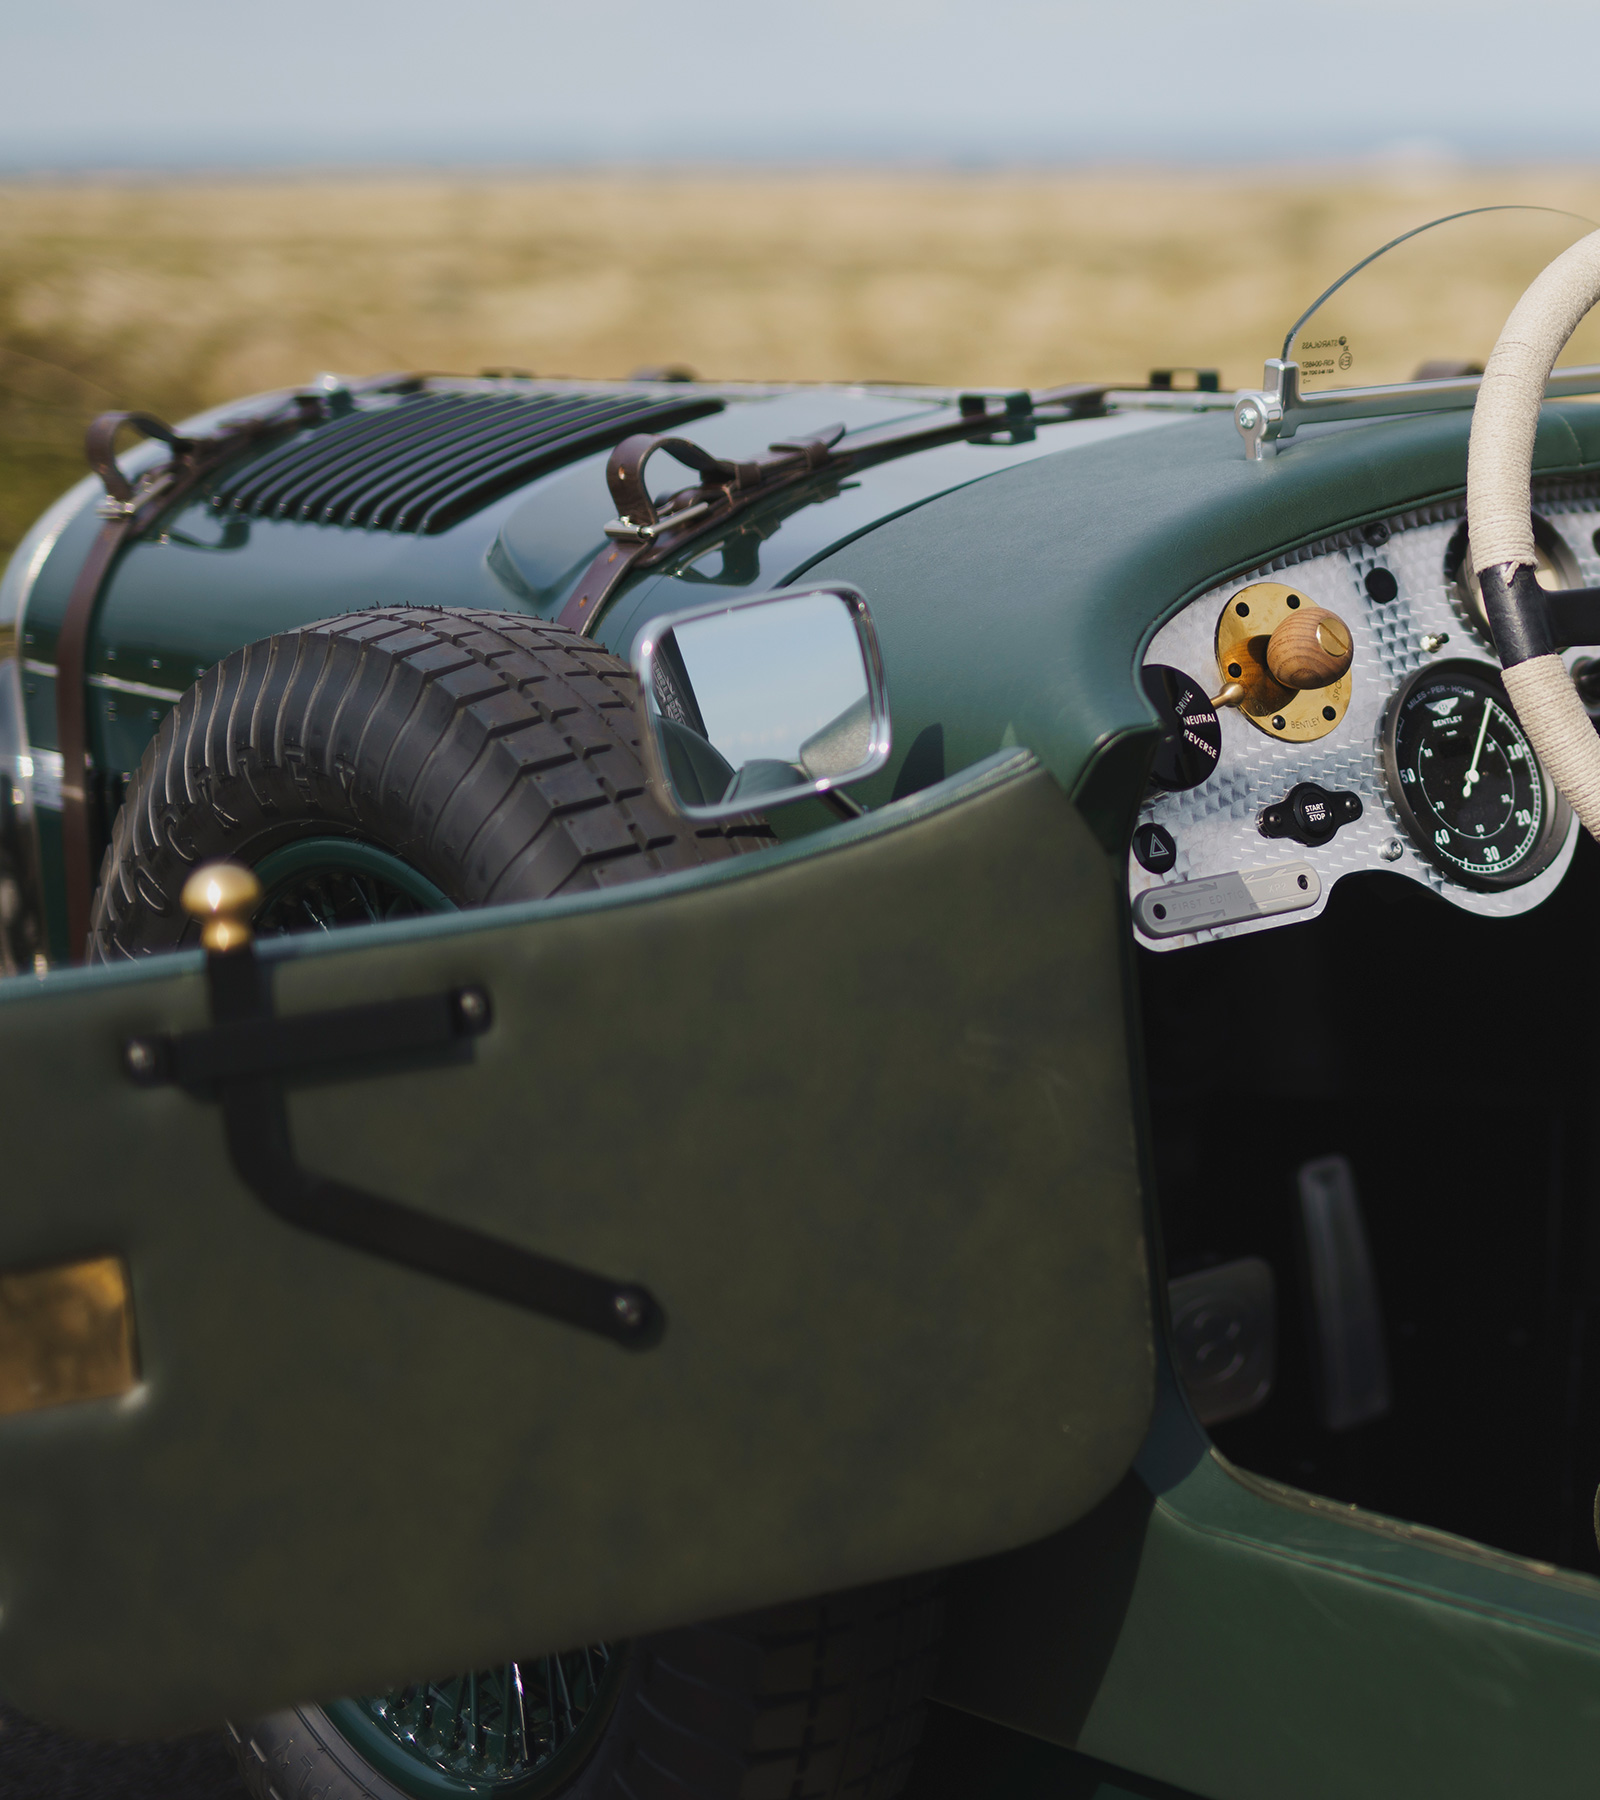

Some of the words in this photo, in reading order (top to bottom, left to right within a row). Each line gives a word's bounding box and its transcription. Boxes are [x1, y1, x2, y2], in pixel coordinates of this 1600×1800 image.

[1175, 690, 1194, 715] DRIVE
[1182, 713, 1216, 726] NEUTRAL
[1291, 716, 1320, 730] BENTLEY
[1432, 715, 1462, 728] BENTLEY
[1183, 729, 1218, 759] REVERSE
[1507, 743, 1524, 760] 10
[1400, 767, 1416, 784] 50
[1305, 803, 1324, 812] START
[1309, 812, 1325, 822] STOP
[1515, 809, 1532, 826] 20
[1435, 829, 1450, 845] 40
[1483, 846, 1500, 862] 30
[1268, 883, 1286, 893] XP2
[1172, 899, 1201, 912] FIRST
